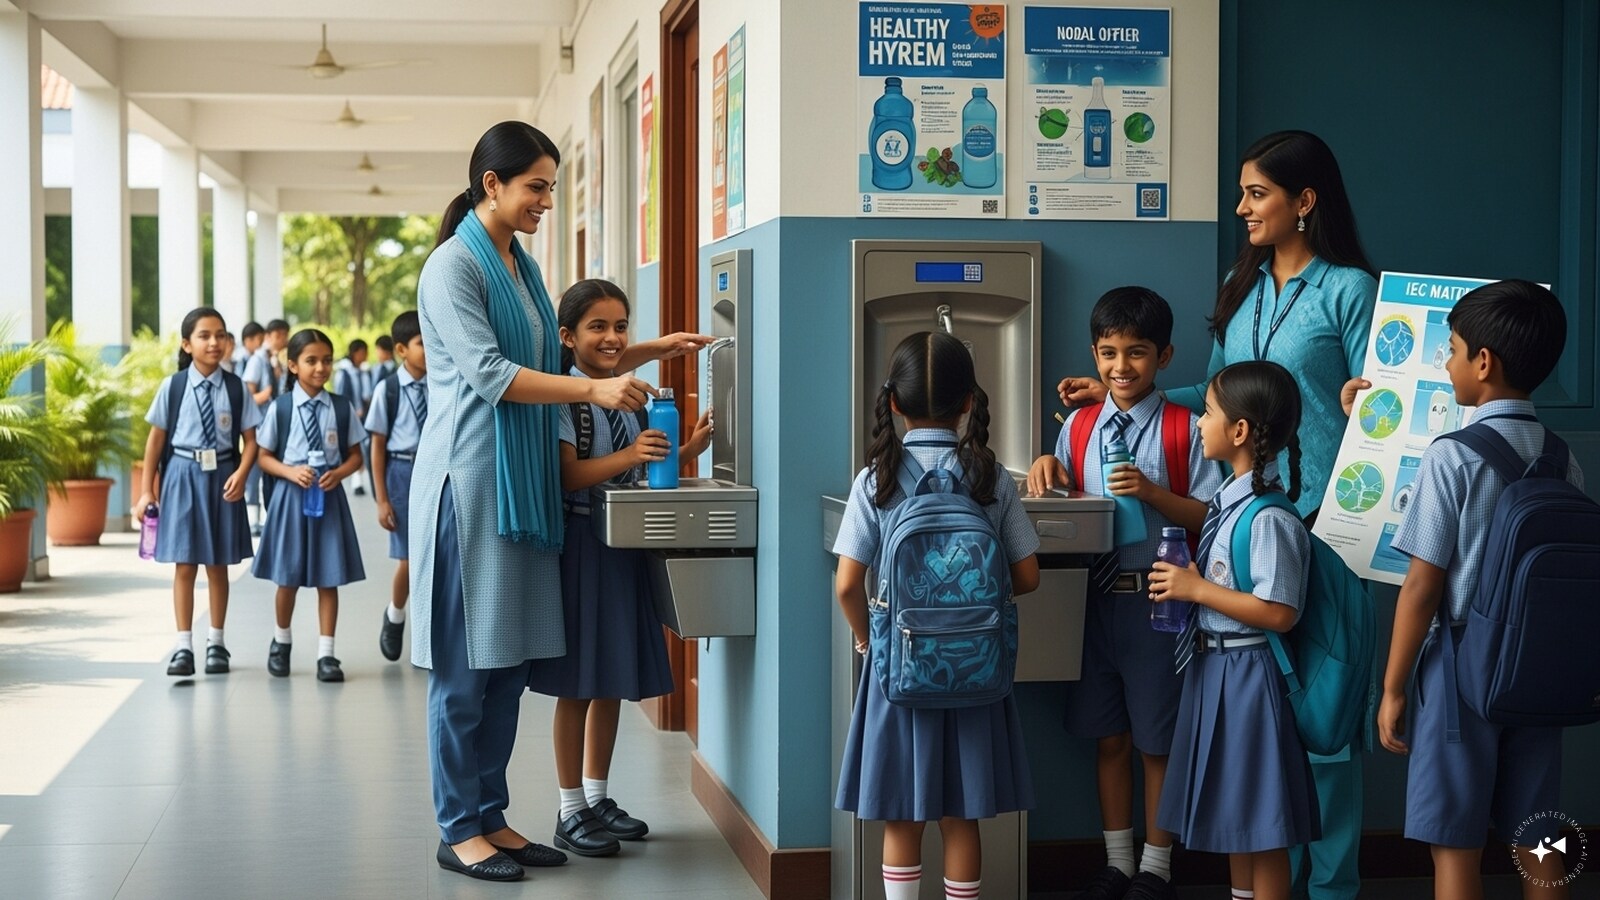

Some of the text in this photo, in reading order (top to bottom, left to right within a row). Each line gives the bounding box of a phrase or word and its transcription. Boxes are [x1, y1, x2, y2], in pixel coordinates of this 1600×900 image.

[870, 17, 950, 40] HEALTHY
[1057, 26, 1096, 41] NODAL
[869, 40, 945, 67] HYREM
[1405, 281, 1428, 297] IEC
